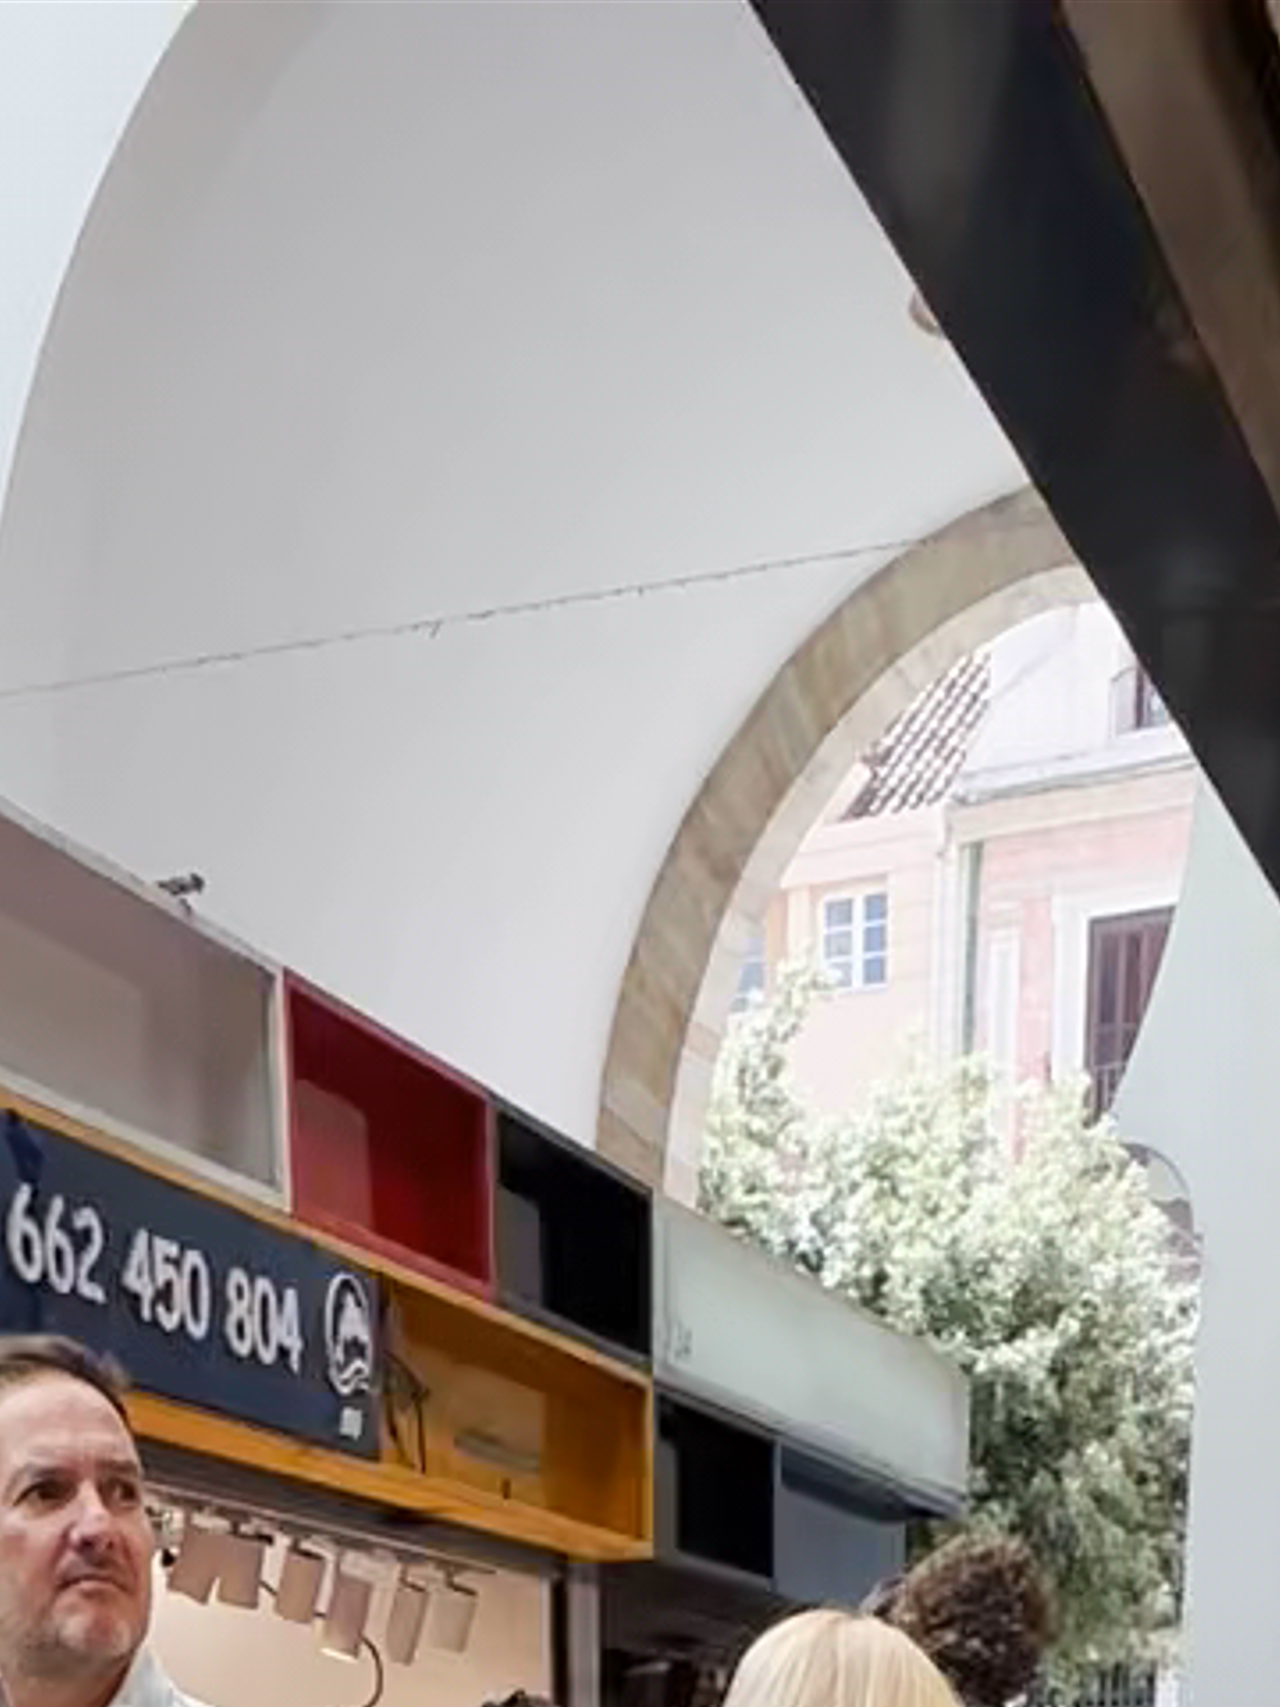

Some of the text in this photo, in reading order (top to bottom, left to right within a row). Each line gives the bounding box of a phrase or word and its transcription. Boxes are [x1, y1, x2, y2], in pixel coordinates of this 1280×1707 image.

[6, 1183, 106, 1305] 662
[122, 1228, 210, 1340] 450
[225, 1267, 304, 1373] 804
